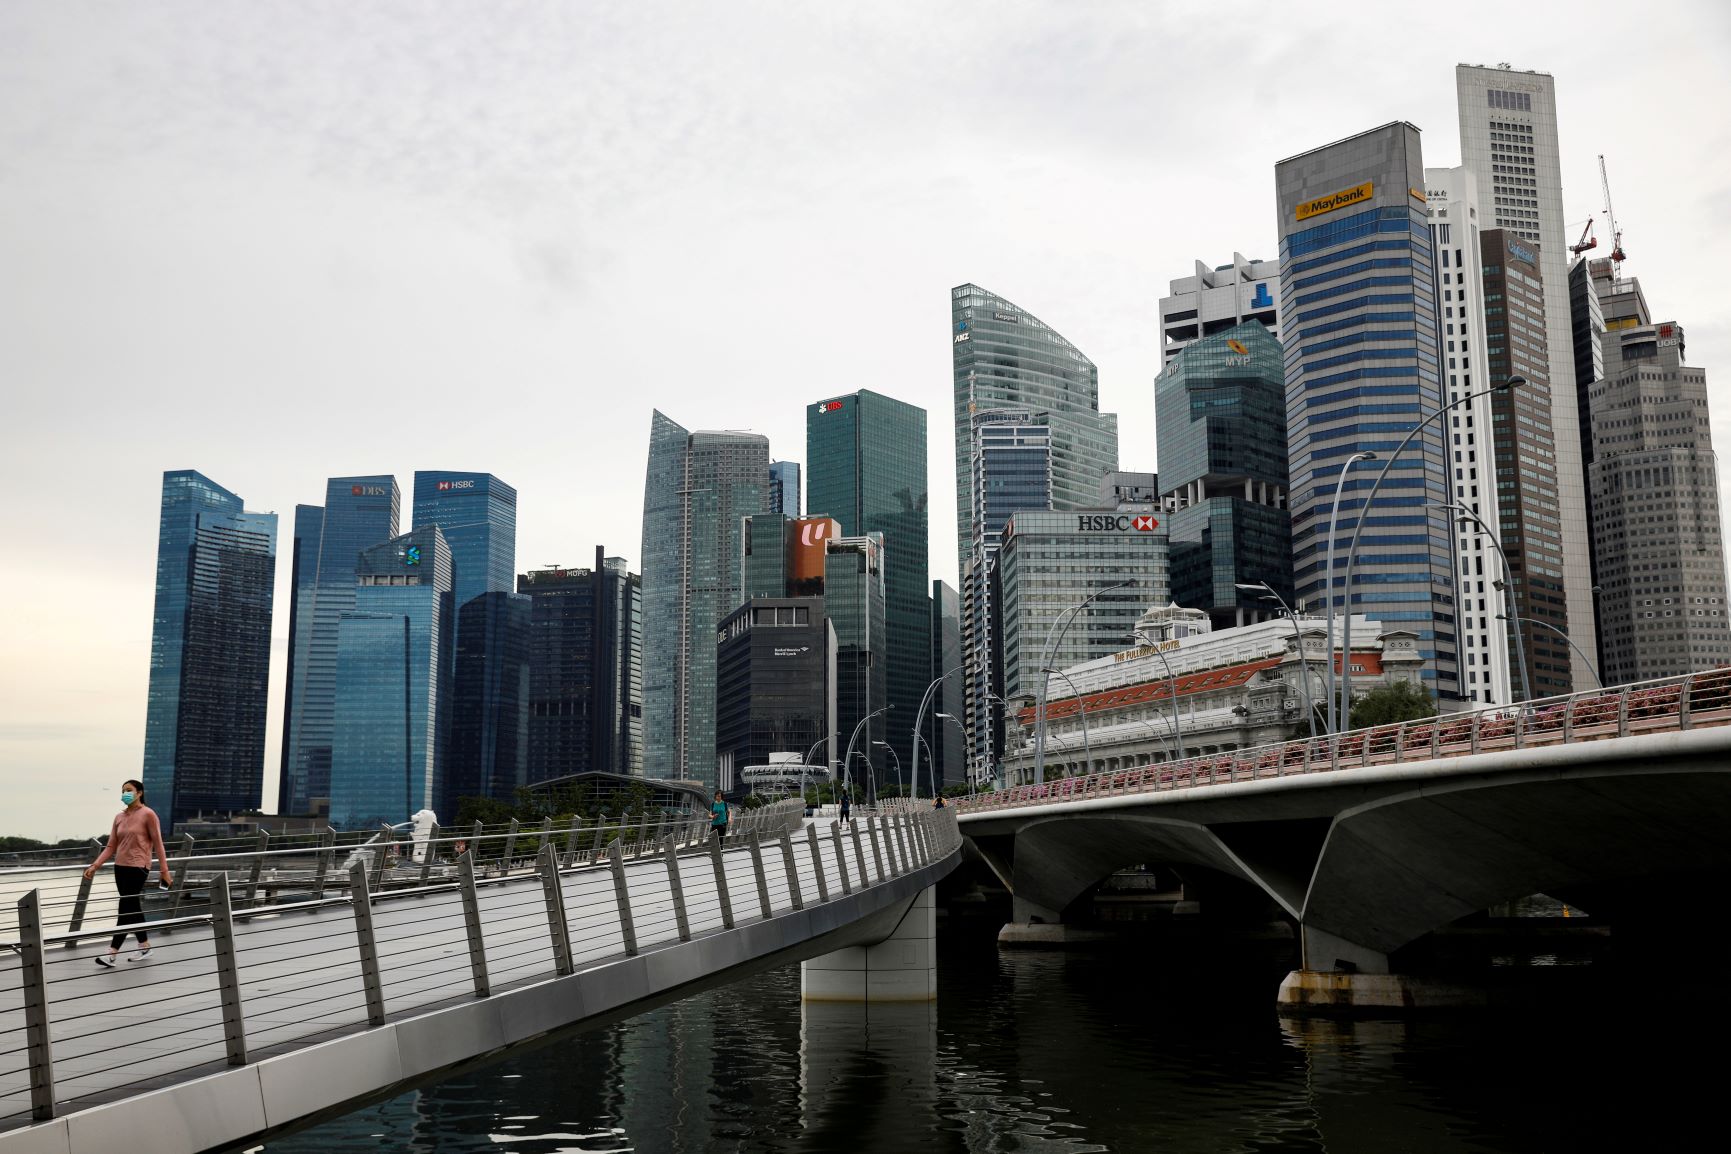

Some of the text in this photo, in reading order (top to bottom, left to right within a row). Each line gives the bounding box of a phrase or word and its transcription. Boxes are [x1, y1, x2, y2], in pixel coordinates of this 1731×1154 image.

[1311, 188, 1364, 213] Maybank
[995, 312, 1017, 321] Keppel
[954, 332, 970, 343] ANZ
[1657, 339, 1677, 348] UOB
[1225, 356, 1250, 367] MYP
[827, 401, 842, 410] UBS
[451, 480, 474, 489] HSBC
[362, 485, 385, 496] DBS
[1077, 515, 1130, 531] HSBC
[1113, 653, 1125, 663] THE
[1160, 639, 1181, 652] HOTEL
